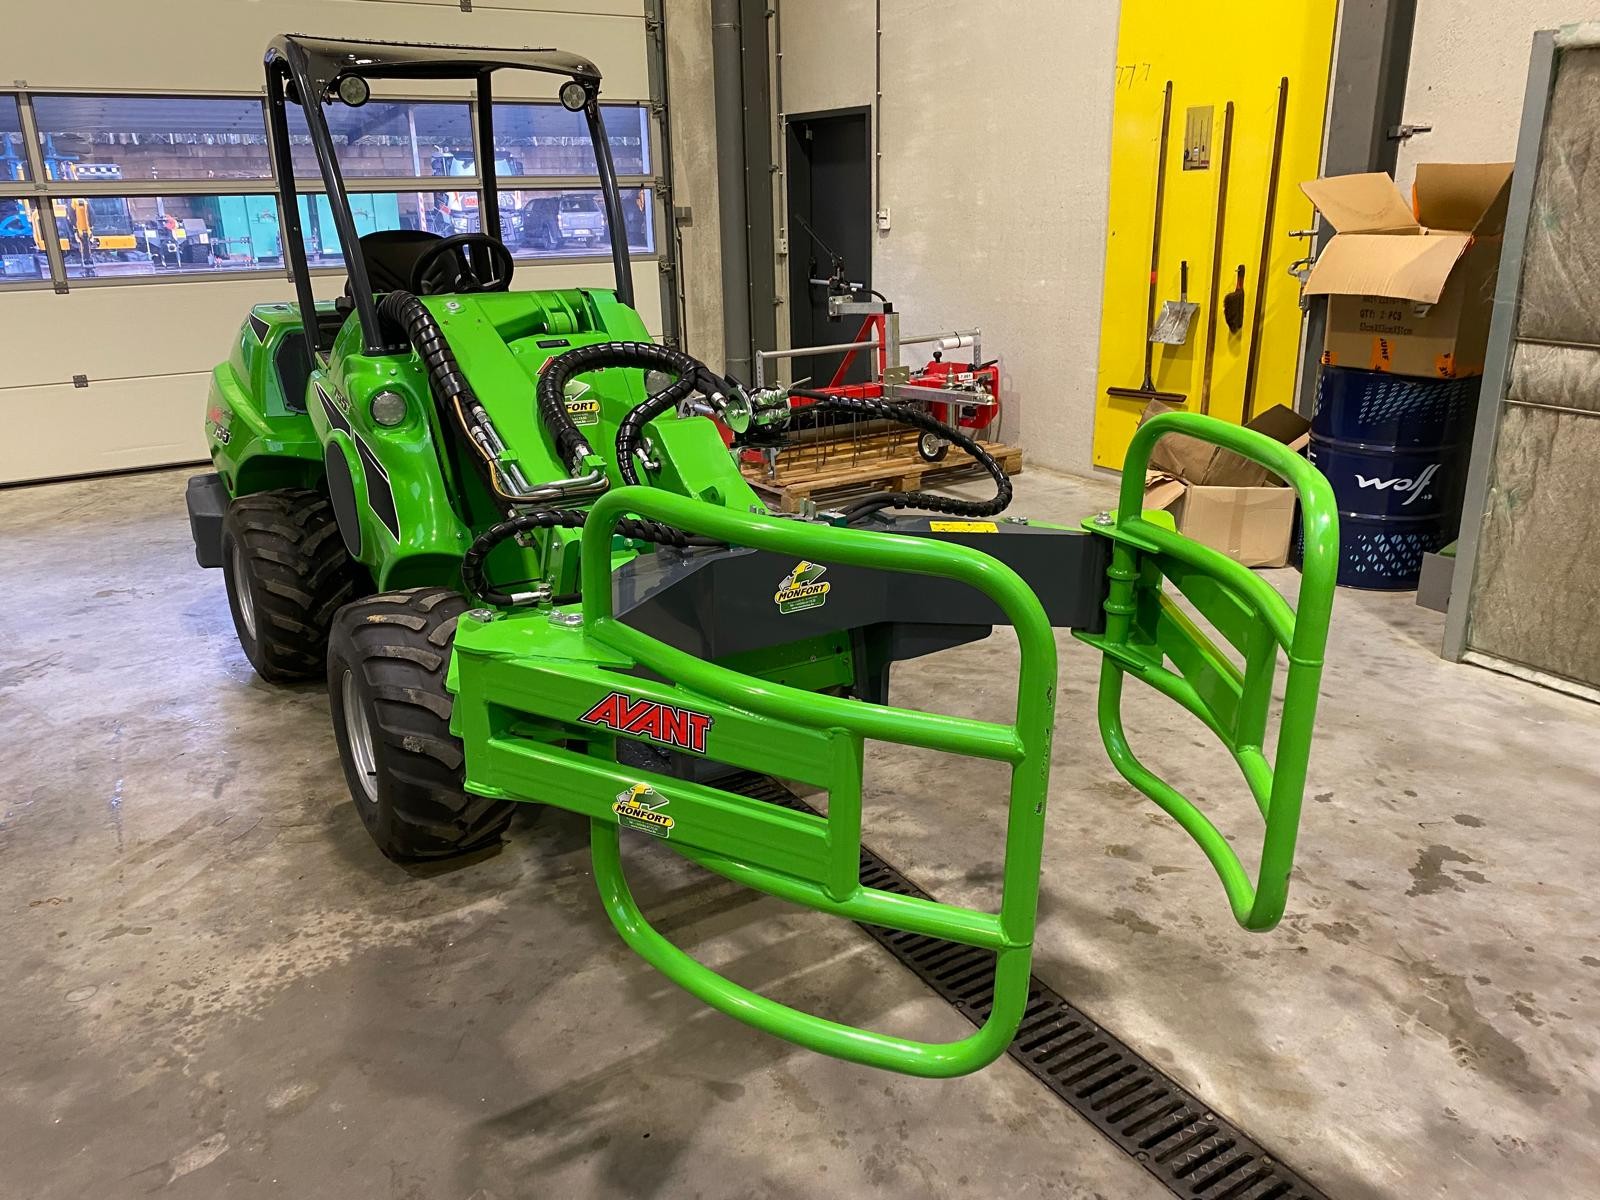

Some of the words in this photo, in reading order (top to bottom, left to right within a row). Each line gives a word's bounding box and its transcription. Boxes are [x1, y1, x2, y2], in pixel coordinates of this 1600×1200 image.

[778, 584, 826, 601] MONFORT
[577, 691, 715, 755] AVANT
[616, 804, 670, 824] MONFORT
